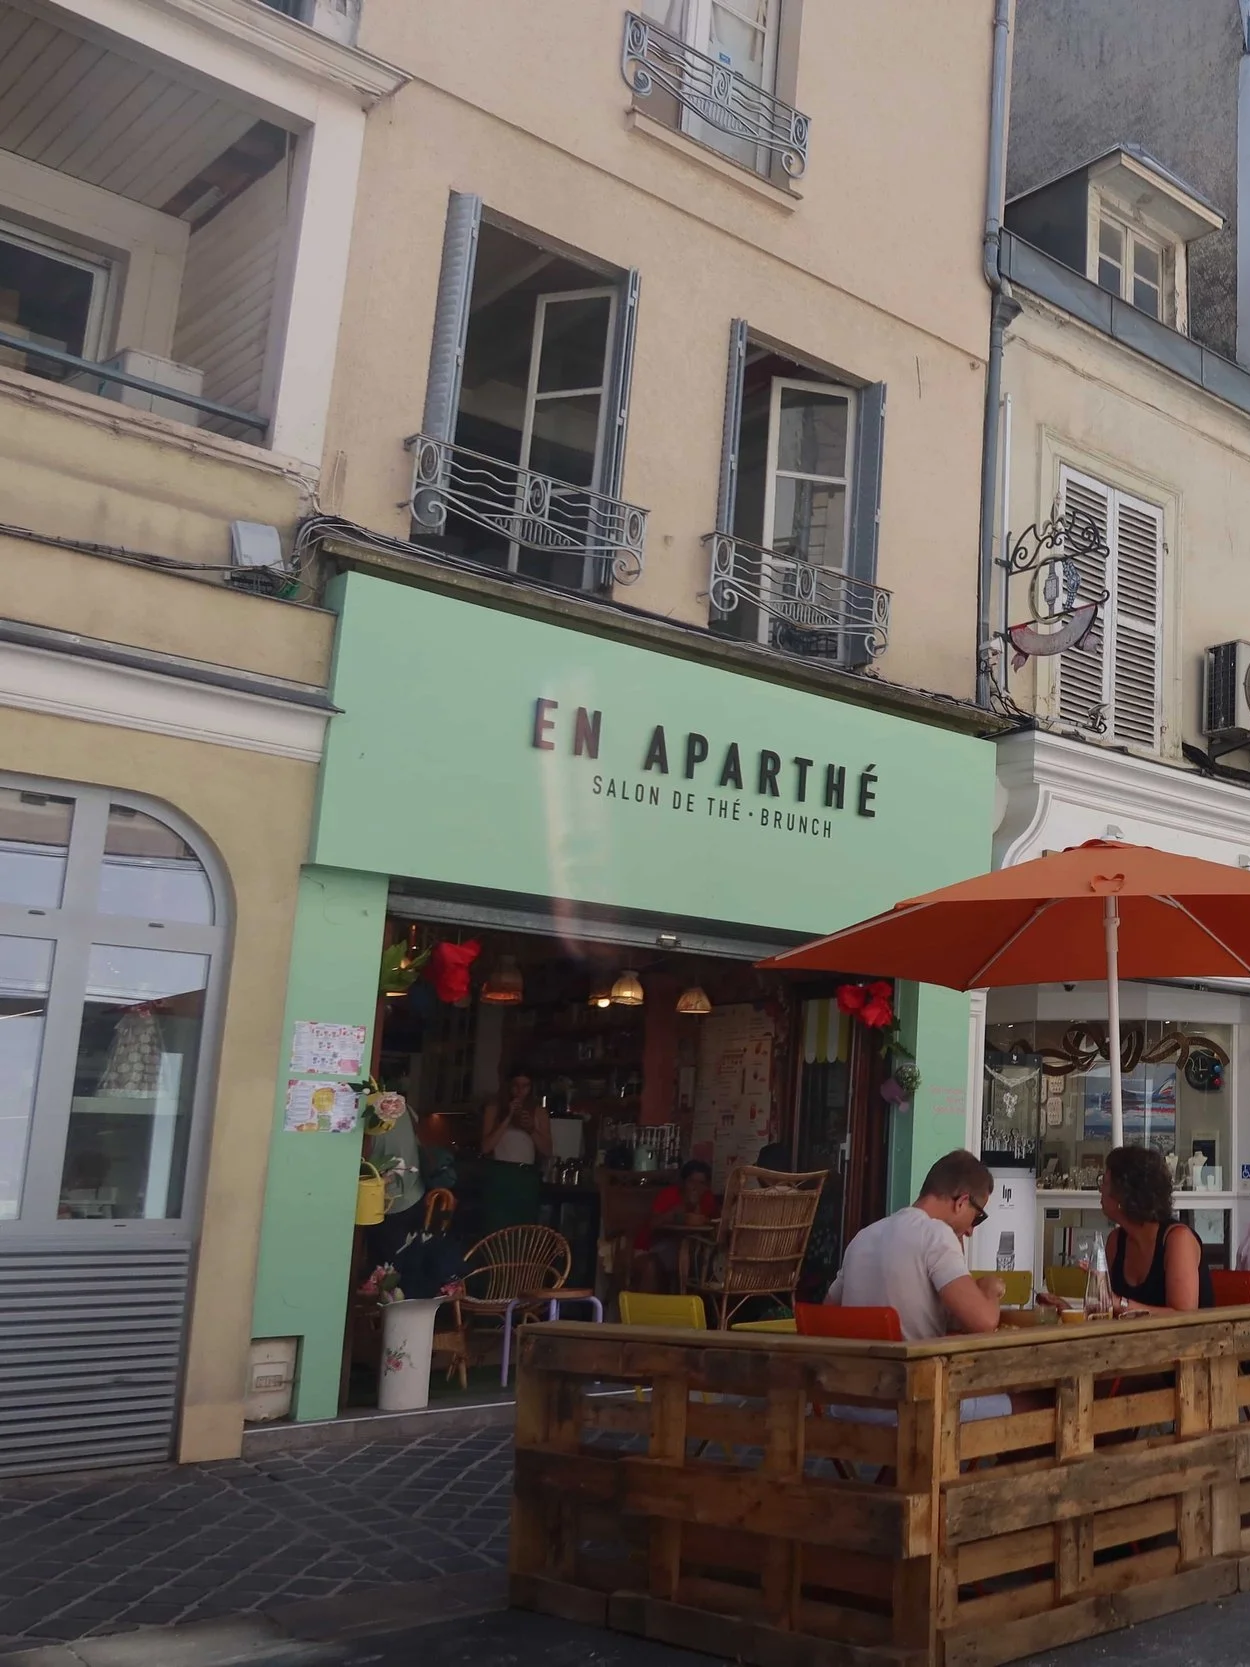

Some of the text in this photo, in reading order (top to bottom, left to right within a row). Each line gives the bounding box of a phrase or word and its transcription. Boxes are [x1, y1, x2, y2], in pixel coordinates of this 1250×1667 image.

[532, 697, 878, 817] EN APARTHÉ
[592, 775, 832, 838] SALON DE THÉ BRUNCH
